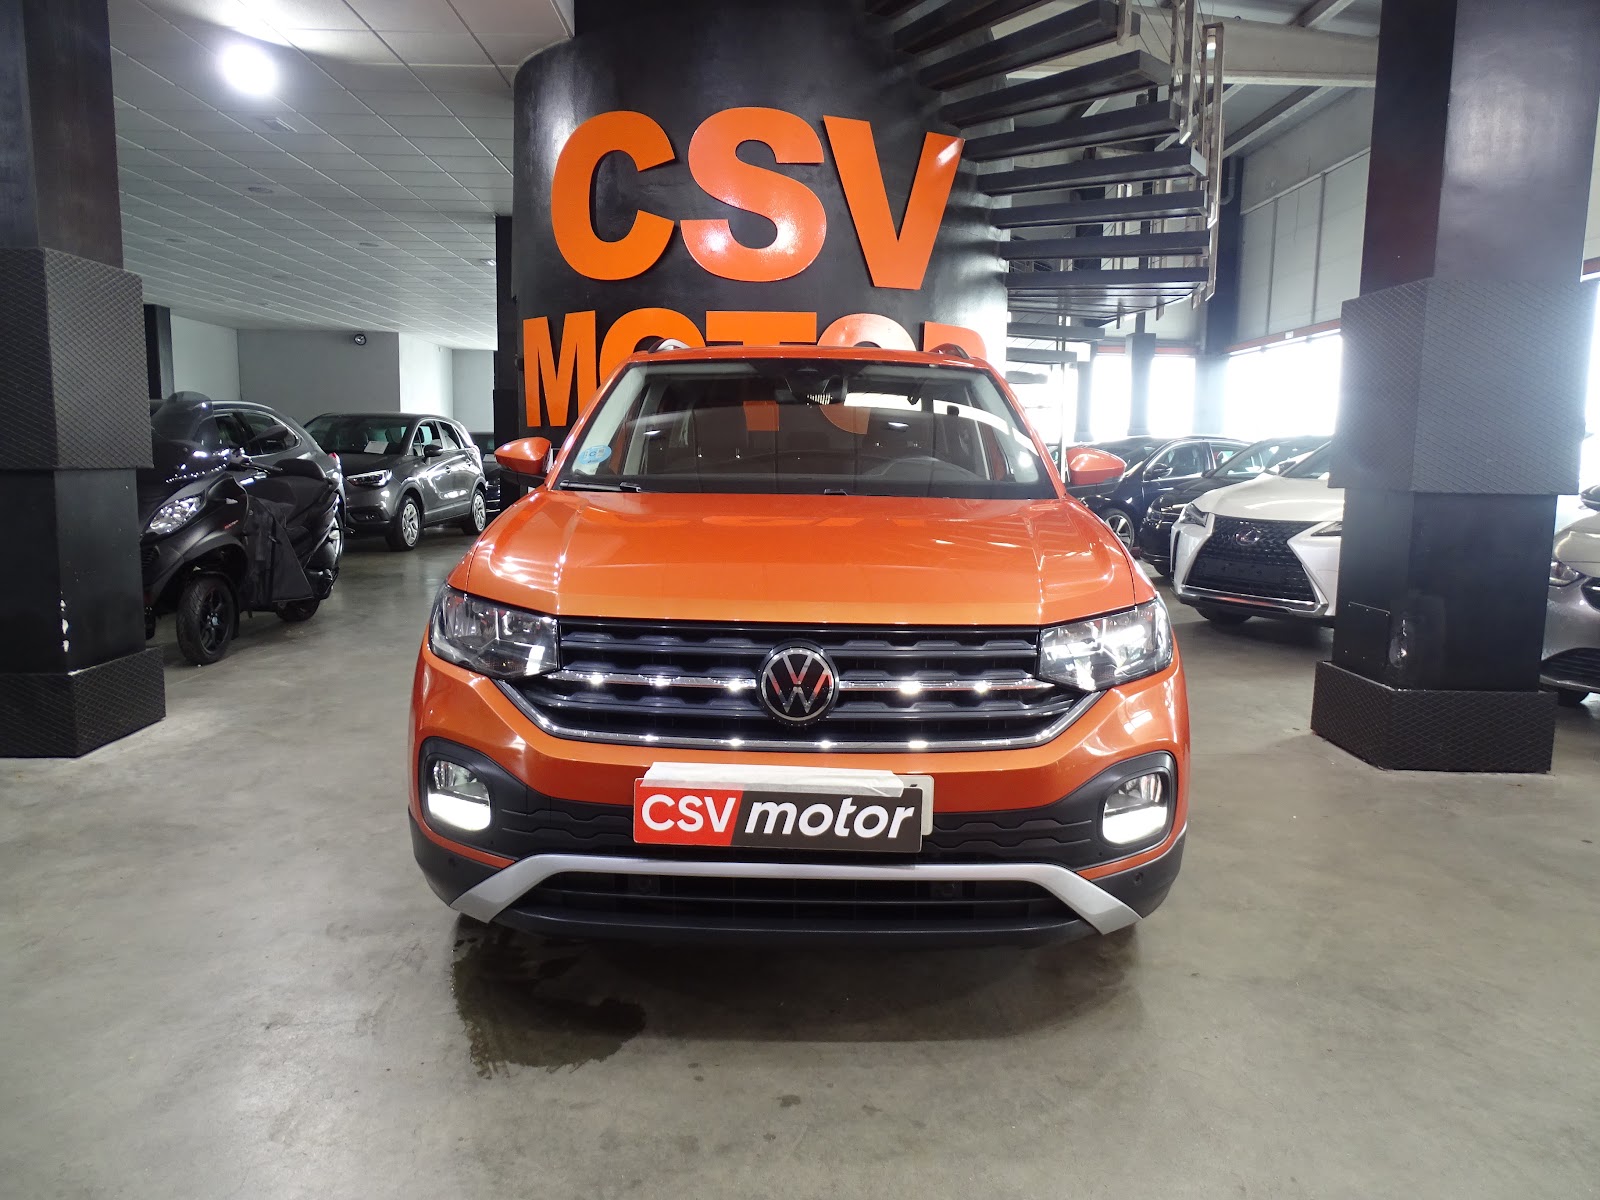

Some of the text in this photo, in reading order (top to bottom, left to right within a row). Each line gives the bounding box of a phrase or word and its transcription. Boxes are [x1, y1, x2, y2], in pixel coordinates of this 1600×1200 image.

[551, 107, 965, 290] CSV
[763, 650, 833, 717] VW
[641, 794, 914, 838] CSV motor
